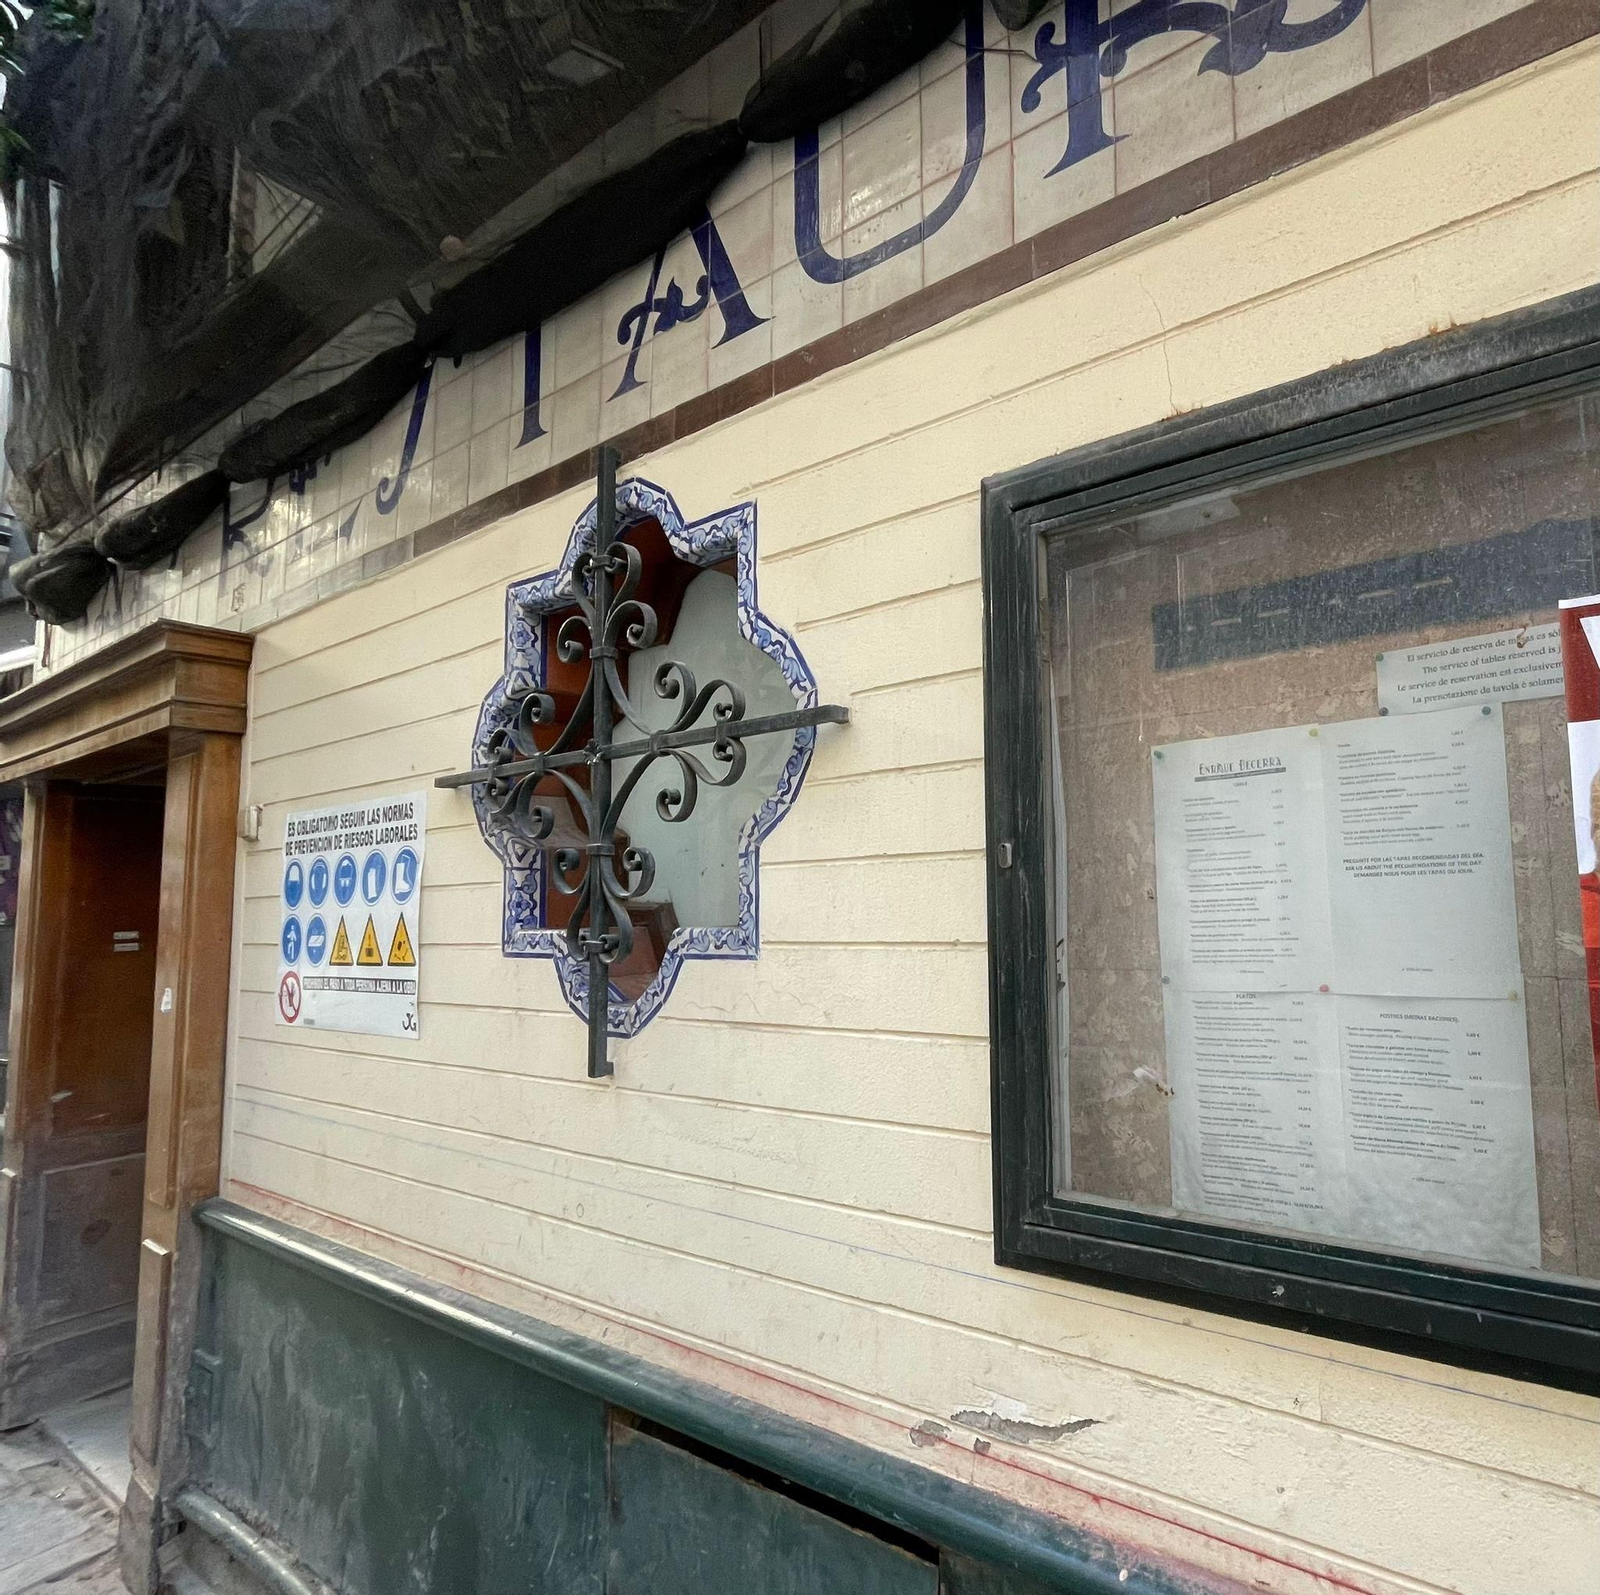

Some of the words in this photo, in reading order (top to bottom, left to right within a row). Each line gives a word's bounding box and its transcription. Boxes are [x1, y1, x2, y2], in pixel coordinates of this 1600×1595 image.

[1416, 649, 1448, 662] servicio
[1450, 645, 1460, 655] de
[1462, 642, 1493, 653] reserva
[1495, 639, 1506, 648] de
[1422, 665, 1438, 675] The
[1439, 660, 1468, 672] service
[1470, 657, 1480, 667] of
[1481, 653, 1506, 665] tables
[1508, 646, 1546, 661] reserved
[1548, 645, 1556, 654] is
[1397, 683, 1407, 693] Le
[1408, 679, 1437, 691] service
[1438, 676, 1449, 686] de
[1450, 669, 1498, 684] reservation
[1500, 667, 1512, 677] est
[1424, 688, 1479, 705] prenotazione
[1480, 685, 1491, 695] de
[1493, 681, 1519, 693] tavola
[288, 821, 296, 838] ES
[296, 814, 339, 836] OBLIGATORIO
[340, 810, 366, 830] SEGUIR
[367, 807, 381, 826] LAS
[382, 802, 414, 823] NORMAS
[285, 841, 293, 857] DE
[333, 834, 343, 850] DE
[344, 829, 374, 849] RIESGOS
[375, 823, 418, 845] LABORALES
